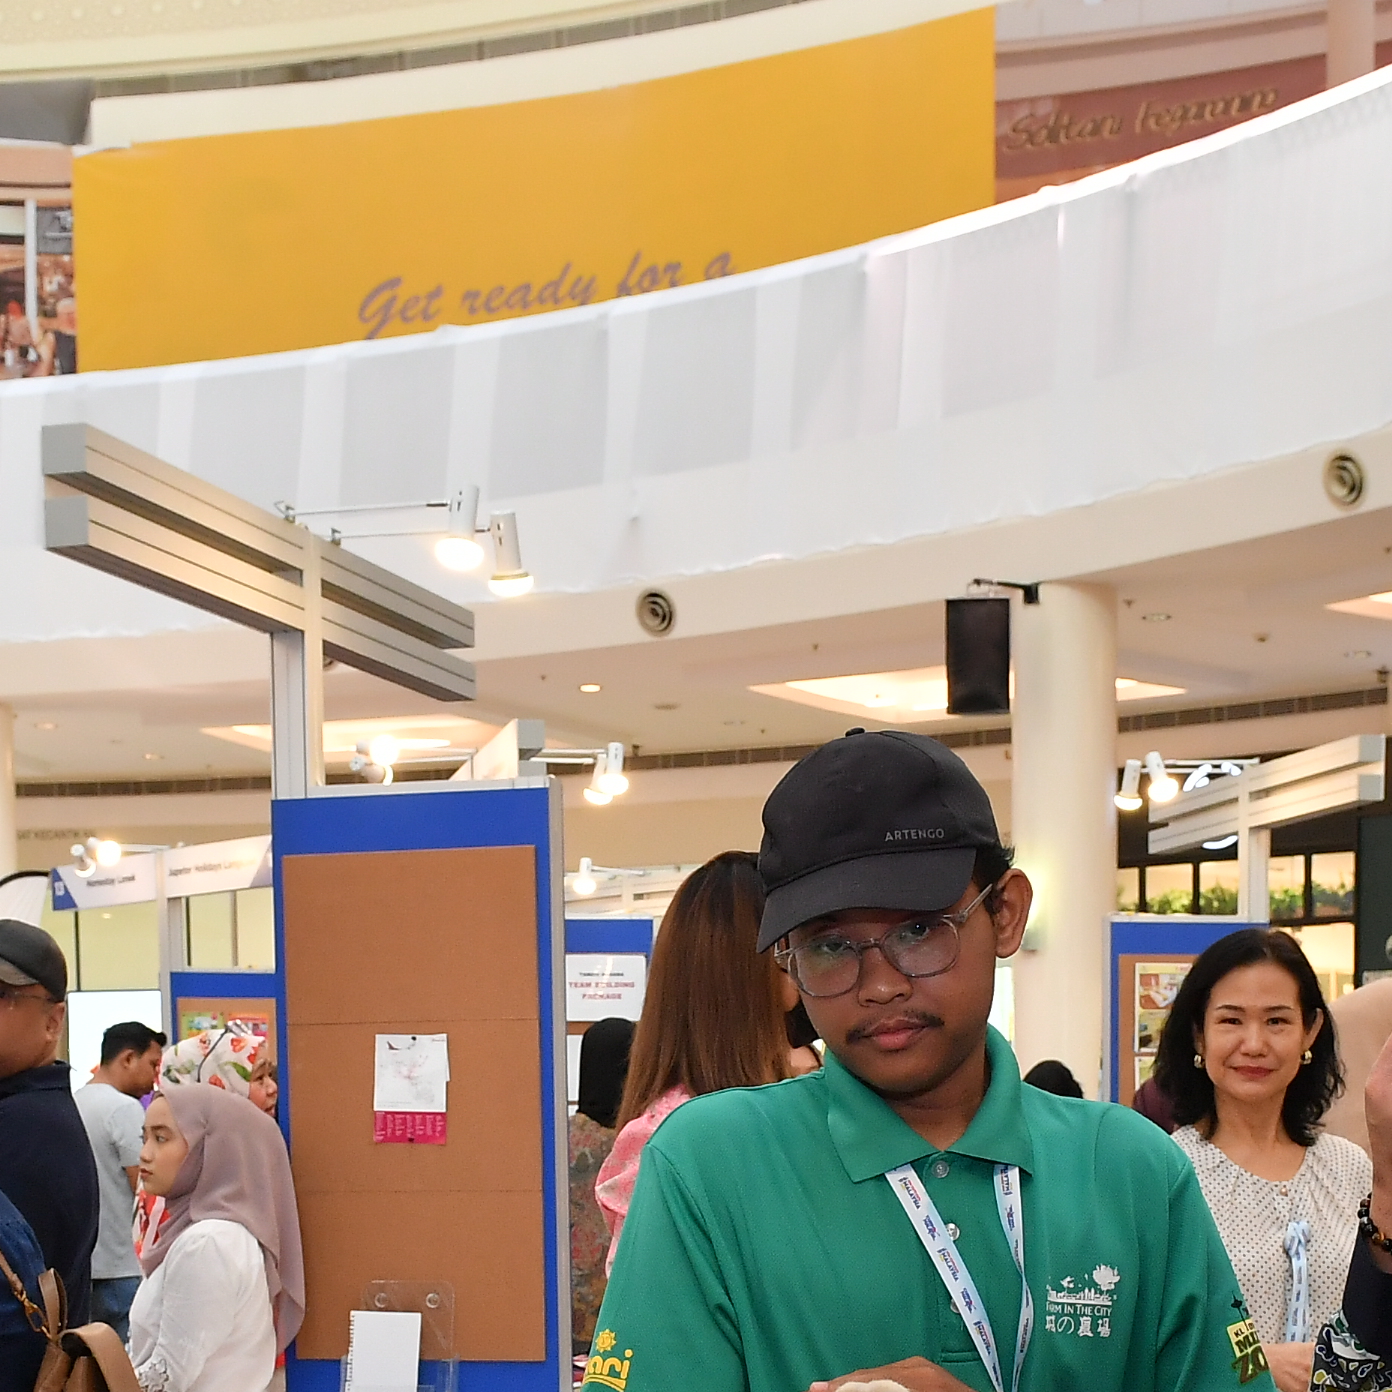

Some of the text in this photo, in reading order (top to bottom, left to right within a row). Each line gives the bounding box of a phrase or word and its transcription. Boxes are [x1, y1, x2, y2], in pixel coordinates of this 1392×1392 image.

[358, 276, 443, 340] Get
[460, 262, 597, 314] ready
[616, 251, 683, 297] for
[885, 828, 945, 842] ARTENGO
[904, 1181, 921, 1210] MALAYSIA
[1064, 1303, 1075, 1315] IN
[1075, 1304, 1094, 1316] THE
[1094, 1306, 1112, 1317] CITY
[1234, 1328, 1245, 1338] KL
